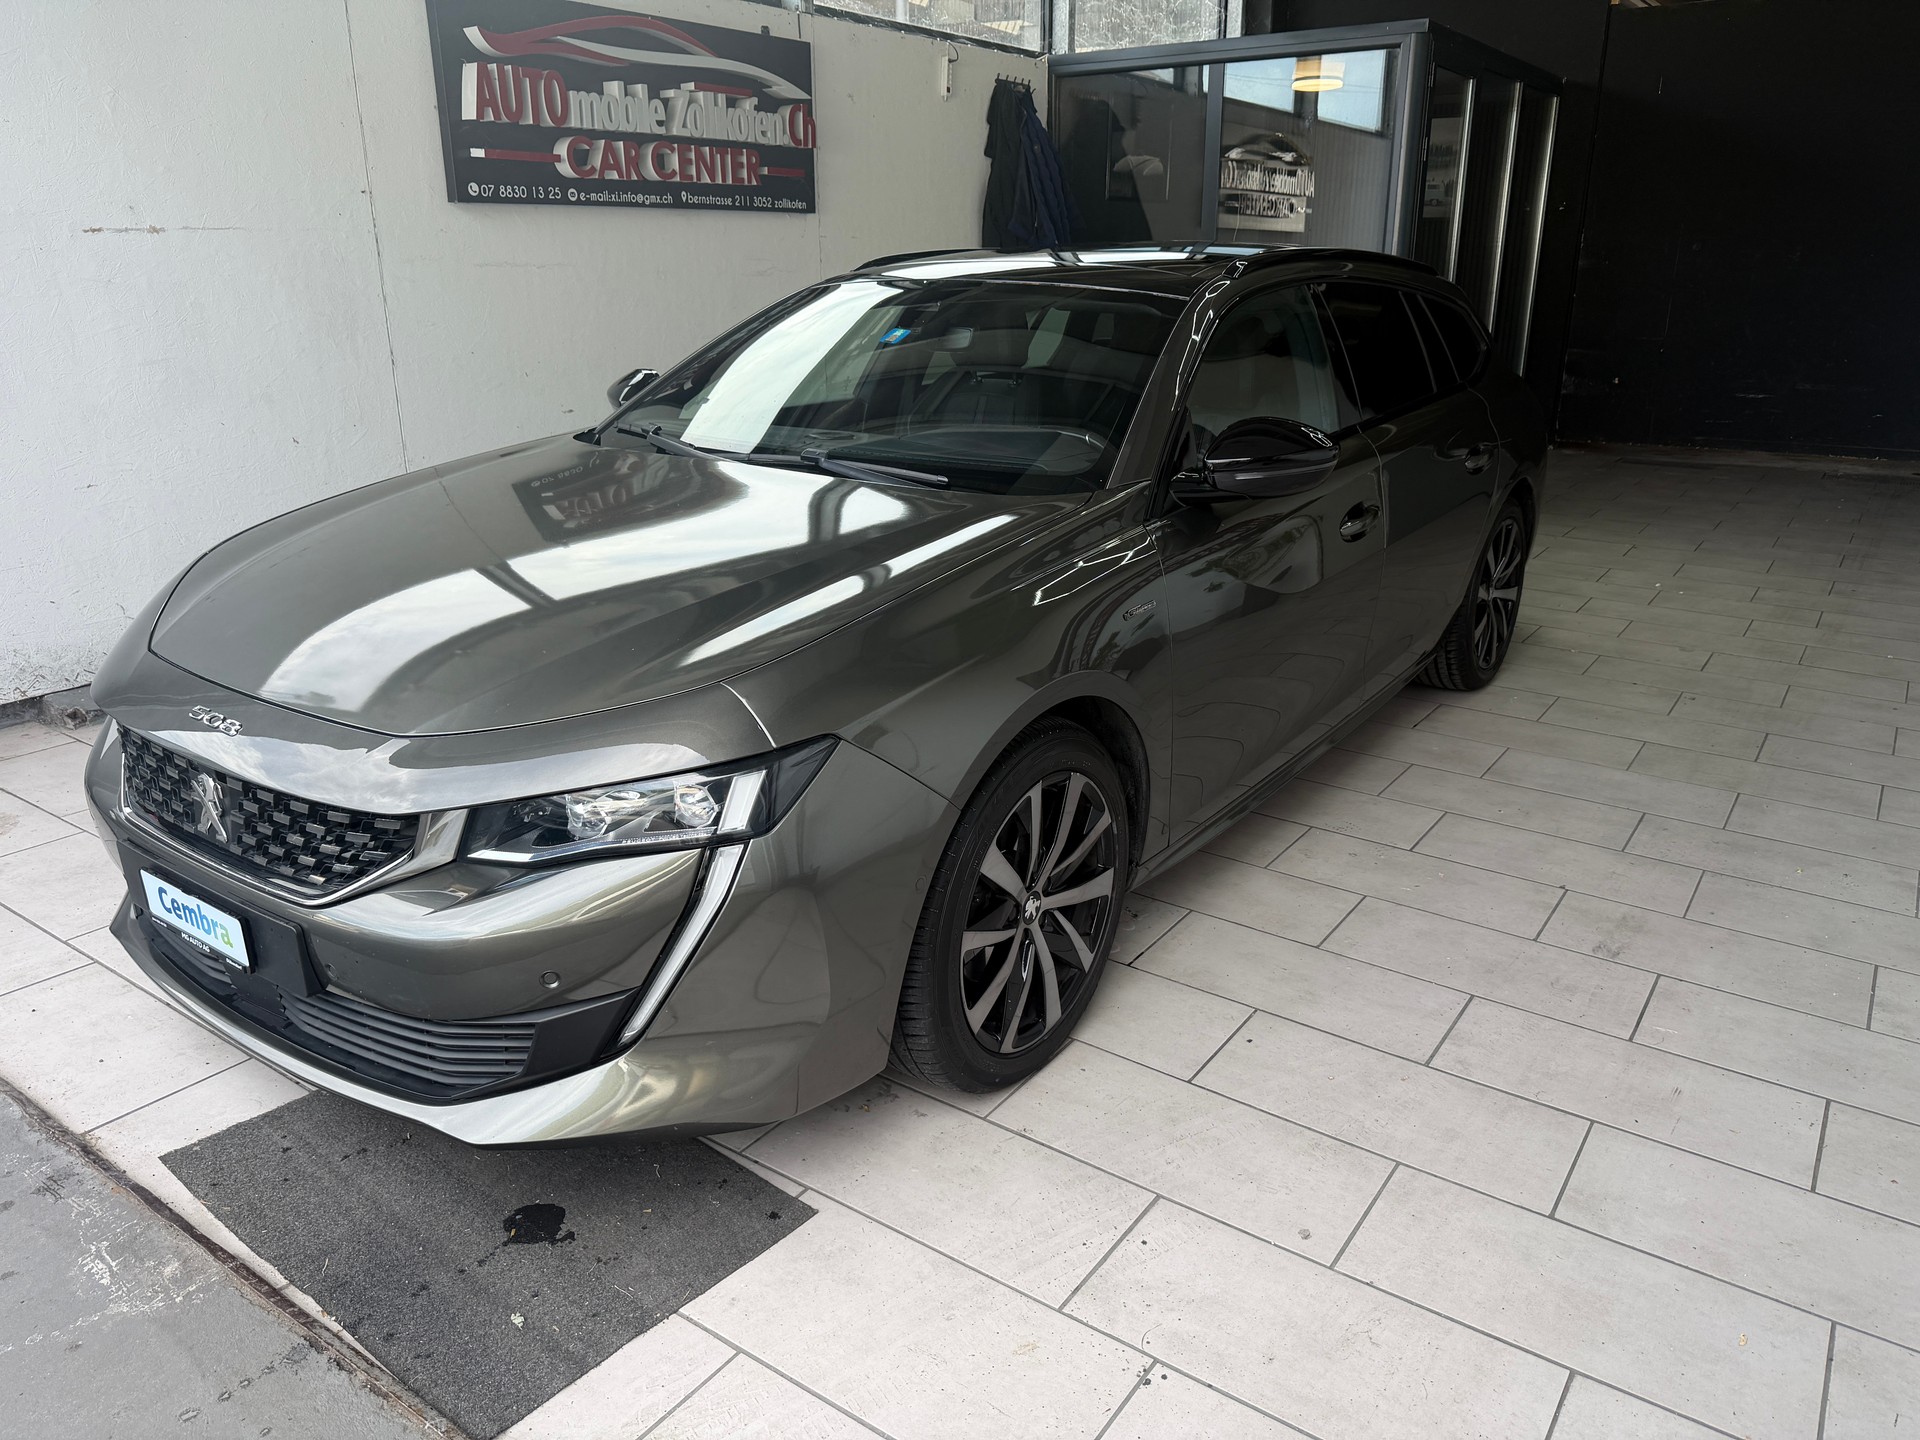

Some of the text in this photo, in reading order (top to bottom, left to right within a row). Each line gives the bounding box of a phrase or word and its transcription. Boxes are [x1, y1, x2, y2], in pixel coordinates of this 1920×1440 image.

[462, 62, 667, 134] AUTOmobile
[555, 136, 762, 186] CAR CENTER
[480, 184, 495, 198] 07
[499, 184, 528, 199] 8830
[532, 186, 545, 199] 13
[549, 186, 562, 200] 25
[687, 192, 733, 207] bernstrasse
[734, 195, 750, 207] 211
[753, 196, 773, 208] 3052
[774, 197, 807, 211] zollikofen
[188, 704, 243, 737] 508
[157, 886, 234, 949] Cembra
[189, 936, 203, 949] AUTO
[202, 944, 211, 953] AG
